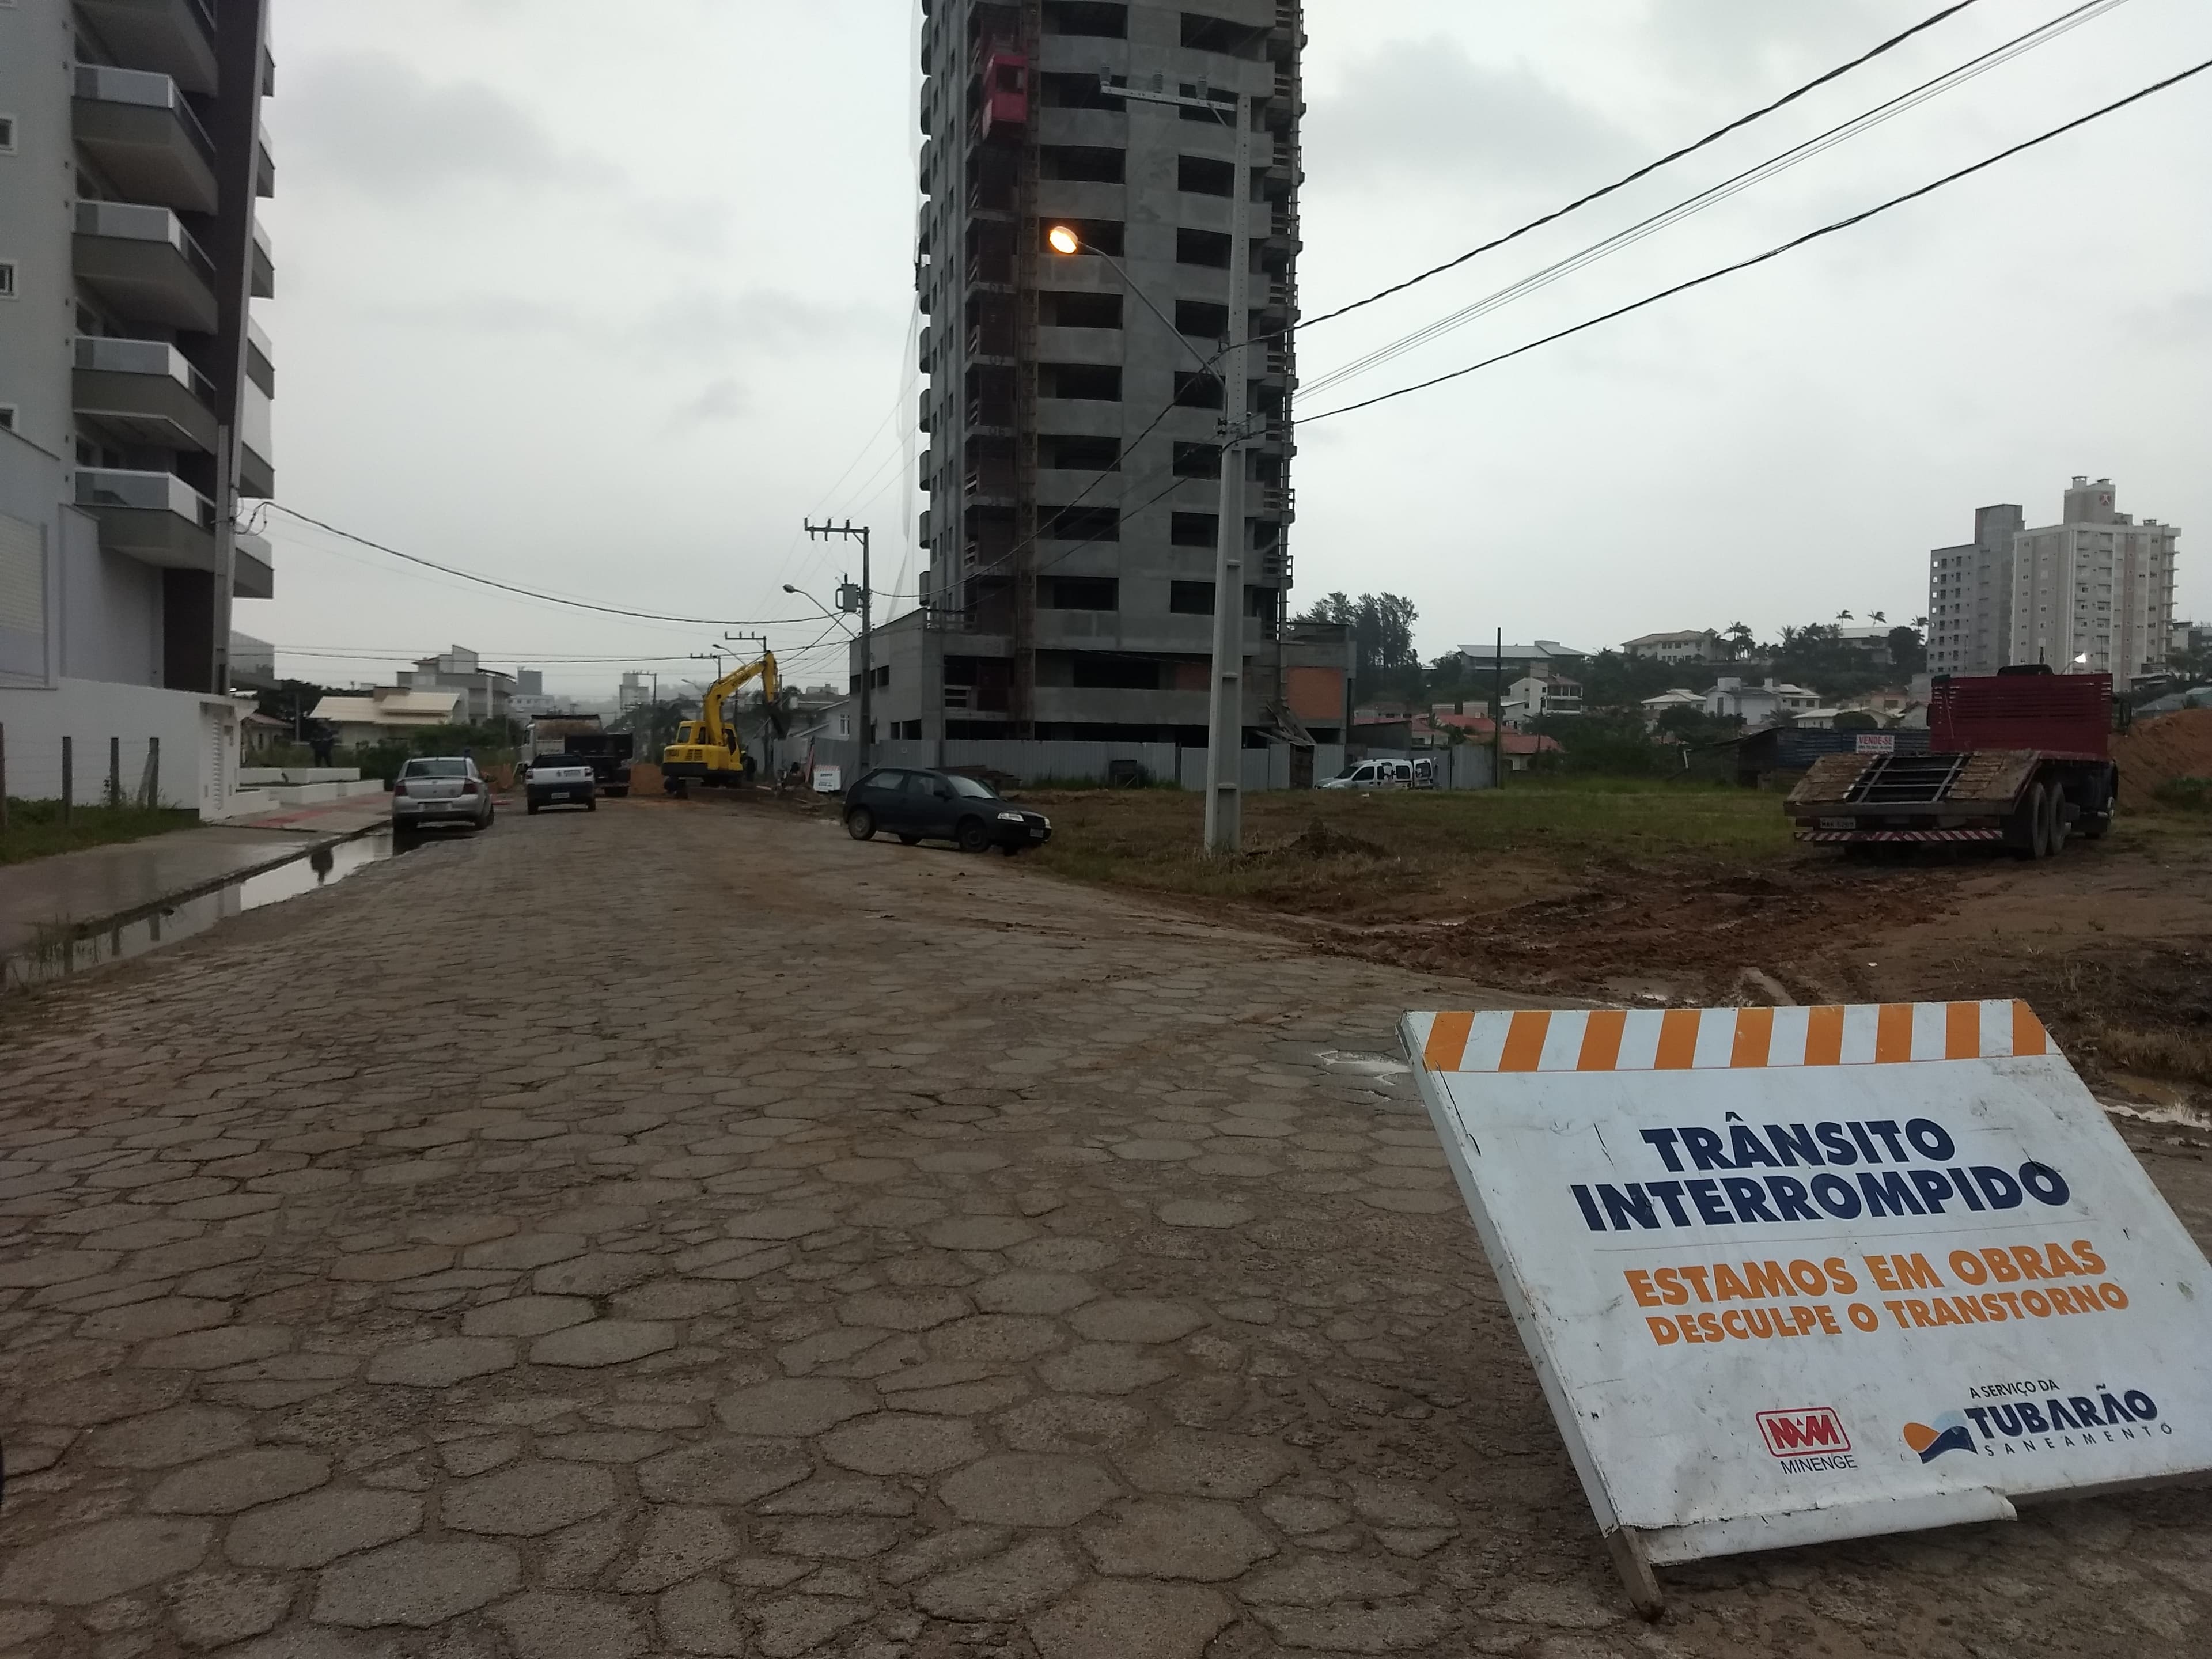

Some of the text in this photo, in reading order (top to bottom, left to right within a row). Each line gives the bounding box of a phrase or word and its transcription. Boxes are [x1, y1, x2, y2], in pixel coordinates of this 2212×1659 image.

[1858, 736, 1893, 745] VENDE-SE
[1639, 1111, 1956, 1172] TRÂNSITO
[1570, 1160, 2070, 1232] INTERROMPIDO
[1624, 1240, 2106, 1307] ESTAMOS EM OBRAS
[1646, 1282, 2128, 1346] DESCULPE O TRANSTORNO
[1963, 1383, 2158, 1440] TUBARÃO
[1969, 1379, 2061, 1399] A SERVIÇO DA
[1780, 1455, 1858, 1475] MINENGE
[1984, 1422, 2173, 1457] SANEAMENTO
